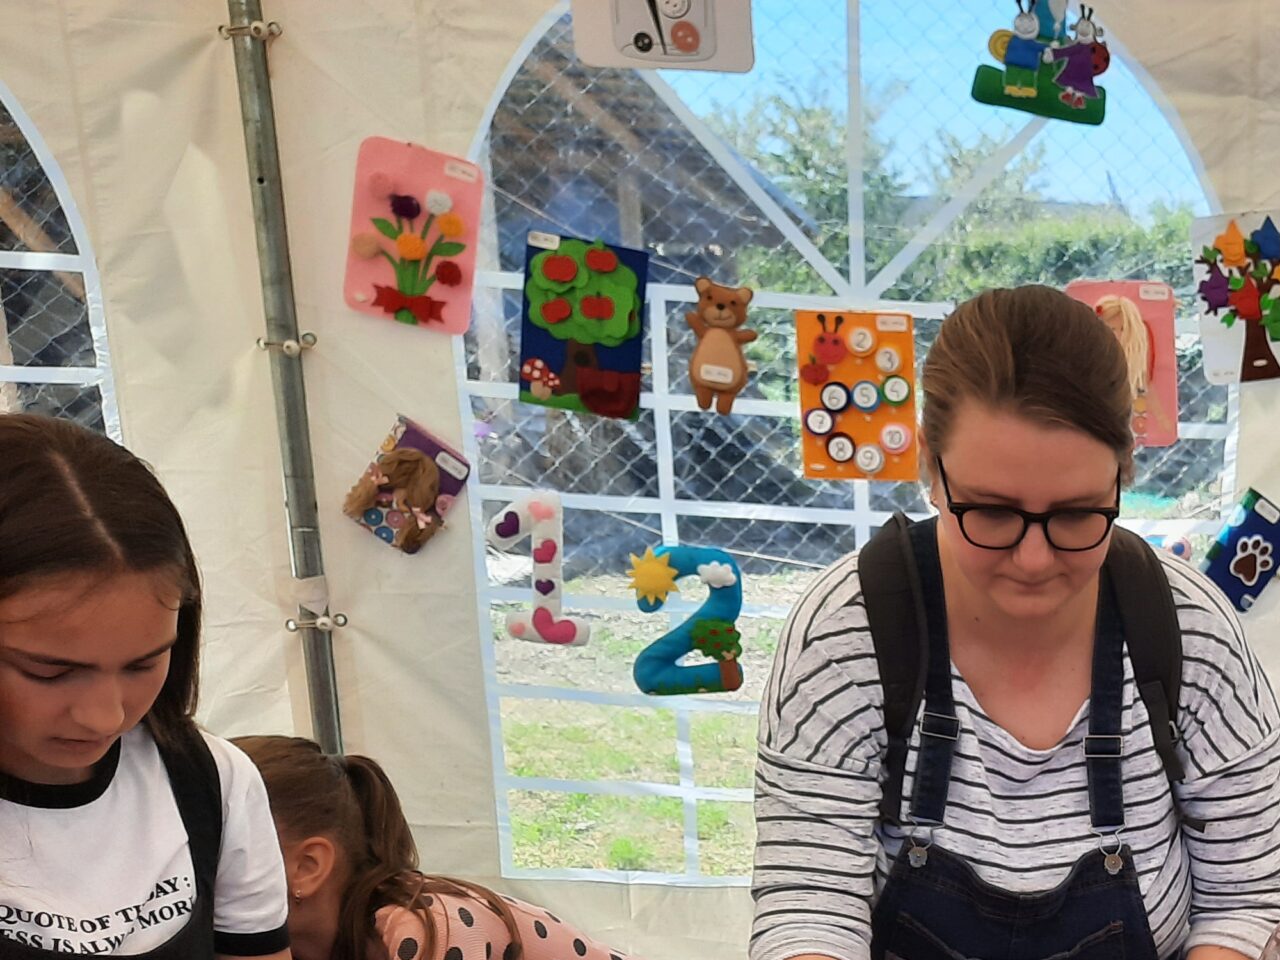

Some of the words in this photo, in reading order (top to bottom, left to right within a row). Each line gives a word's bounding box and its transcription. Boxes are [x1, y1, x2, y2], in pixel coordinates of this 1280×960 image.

[855, 332, 865, 349] 2
[884, 351, 894, 370] 3
[835, 440, 845, 459] 8
[862, 450, 874, 467] 9
[0, 904, 78, 932] QUOTE
[80, 915, 111, 933] OF
[137, 896, 193, 929] MOR
